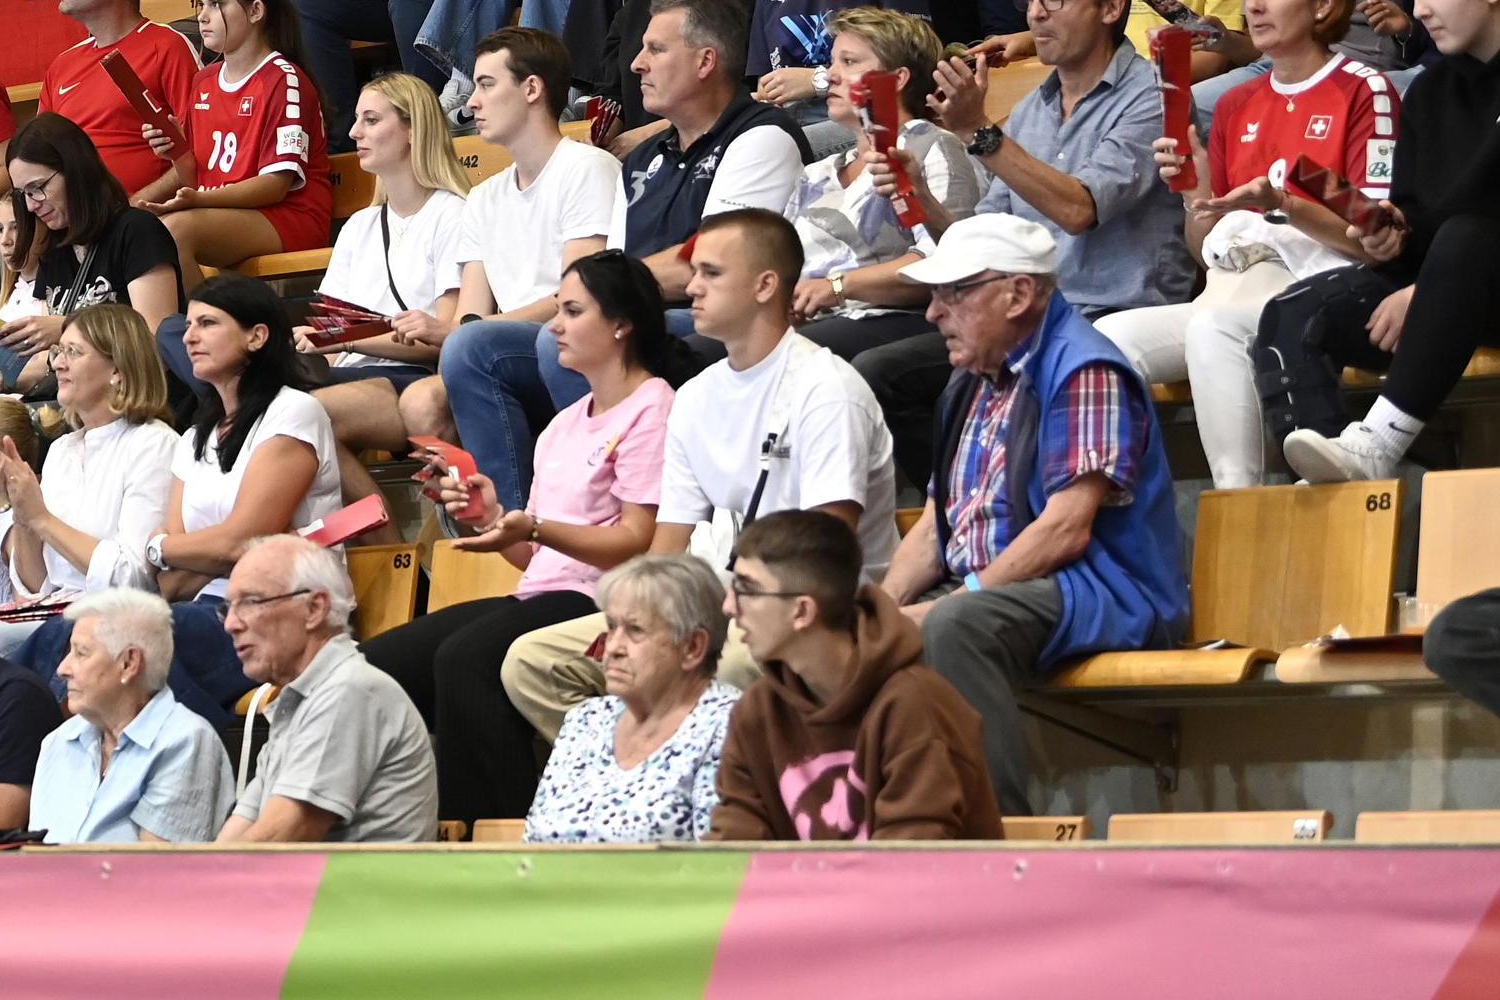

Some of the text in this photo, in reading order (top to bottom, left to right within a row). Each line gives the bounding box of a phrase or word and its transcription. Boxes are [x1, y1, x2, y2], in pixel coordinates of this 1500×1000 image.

[283, 131, 296, 139] WE
[208, 131, 237, 173] 18
[1366, 493, 1391, 511] 68
[394, 554, 411, 568] 63
[1055, 824, 1077, 841] 27
